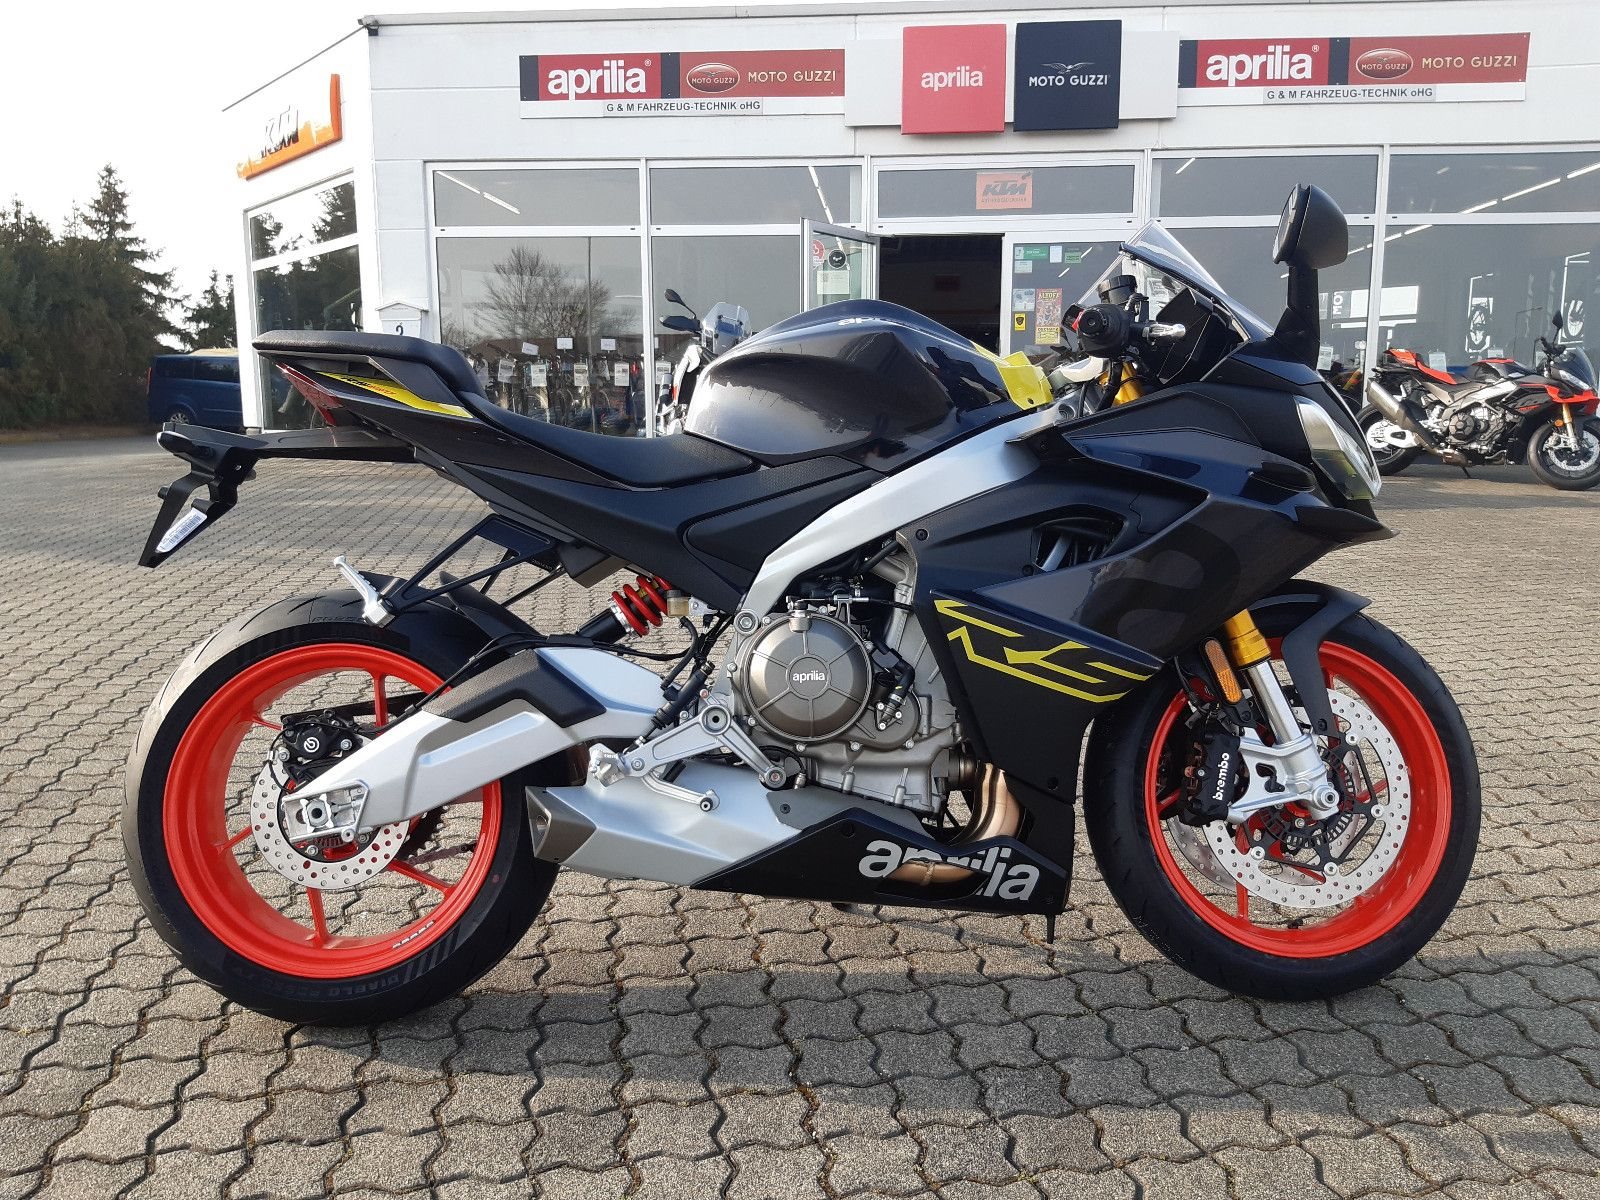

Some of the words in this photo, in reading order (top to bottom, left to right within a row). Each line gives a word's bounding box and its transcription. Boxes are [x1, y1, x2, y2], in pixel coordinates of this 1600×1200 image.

[1206, 45, 1312, 86] aprilia
[1422, 56, 1464, 68] MOTO
[1471, 55, 1517, 67] GUZZI
[547, 60, 646, 100] aprilia
[691, 76, 712, 85] MOTO
[748, 71, 787, 83] MOTO
[793, 70, 837, 82] GUZZI
[920, 66, 983, 91] aprilia
[1029, 76, 1065, 87] MOTO
[1070, 75, 1107, 86] GUZZI
[1267, 90, 1275, 99] G
[1278, 90, 1286, 99] &
[1288, 90, 1297, 98] M
[1300, 88, 1408, 98] FAHRZEUG-TECHNIK
[1411, 88, 1433, 97] oHG
[606, 103, 614, 112] G
[616, 103, 624, 112] &
[626, 103, 634, 112] M
[637, 101, 737, 112] FAHRZEUG-TECHNIK
[740, 101, 760, 111] oHG
[983, 180, 1026, 196] KTM
[793, 671, 825, 683] aprilia
[1212, 753, 1229, 800] brembo
